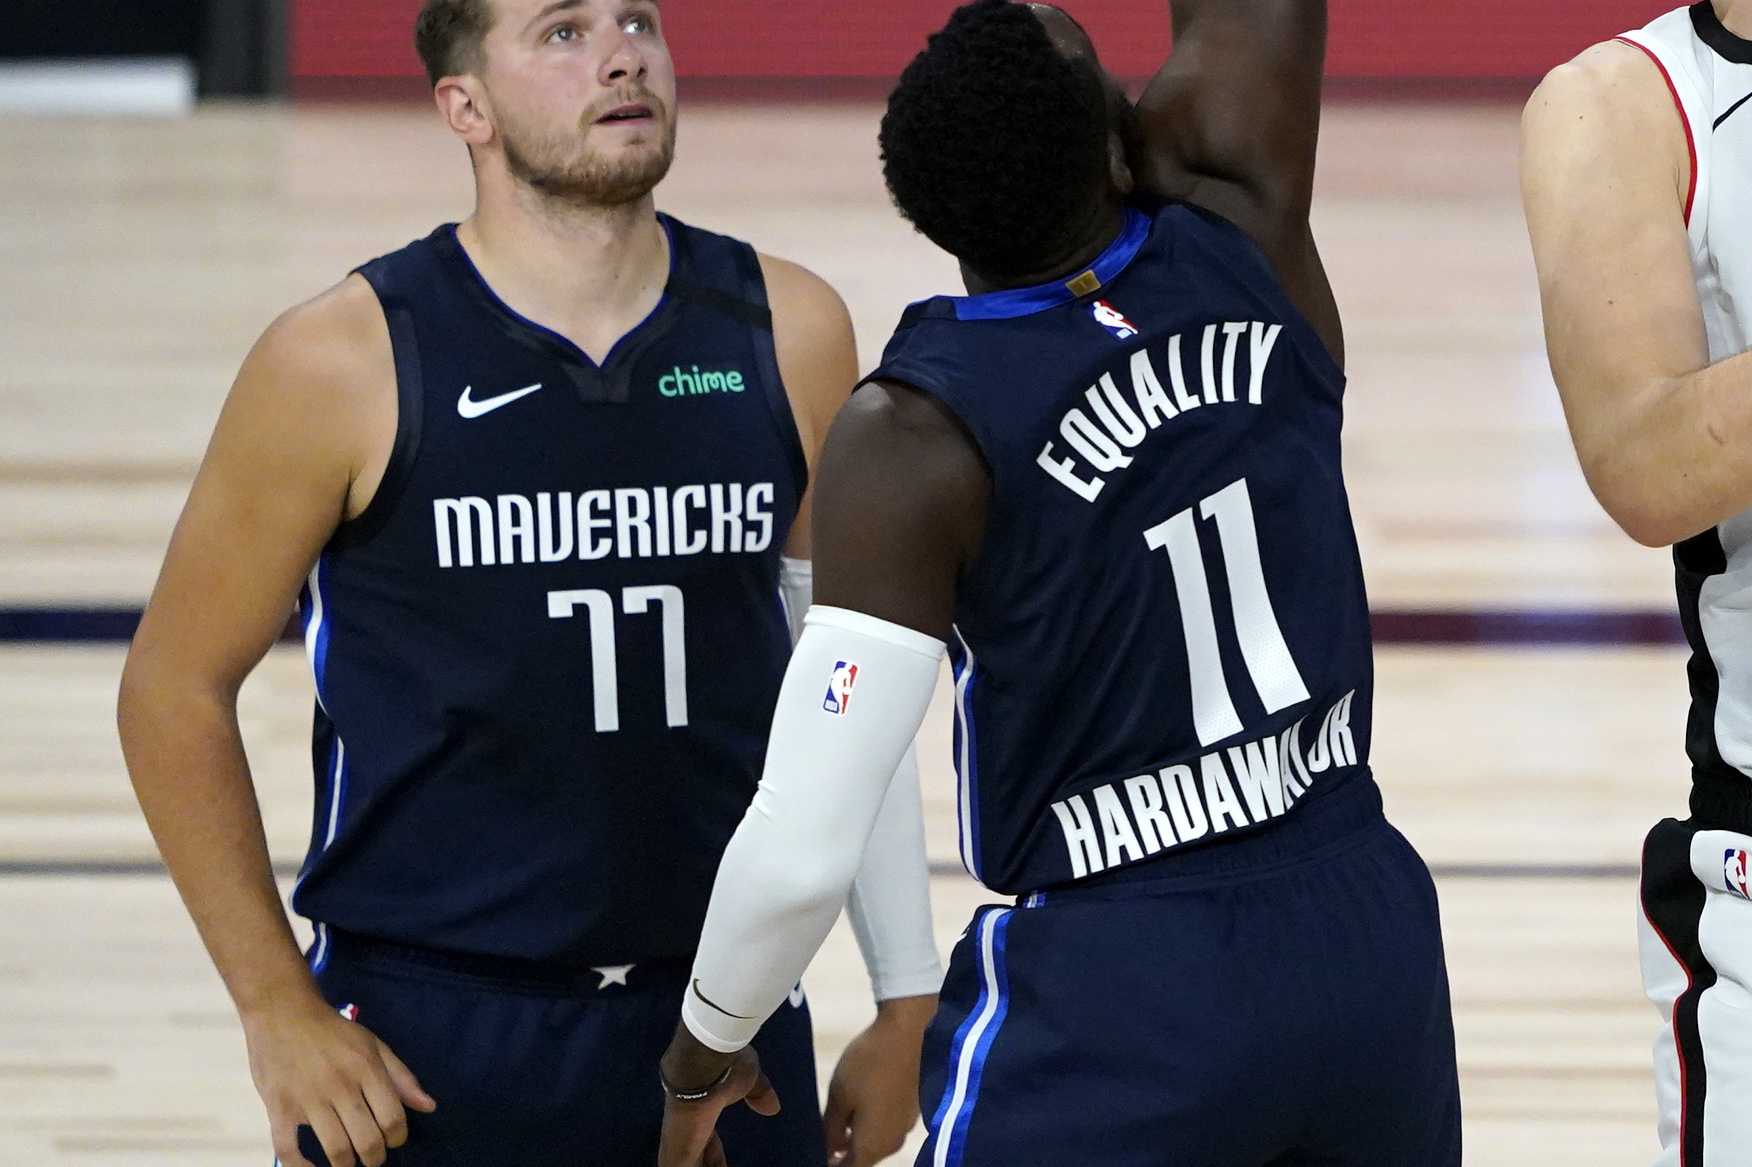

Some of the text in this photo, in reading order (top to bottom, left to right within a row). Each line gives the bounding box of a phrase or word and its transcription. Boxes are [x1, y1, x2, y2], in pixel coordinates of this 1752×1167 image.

[659, 365, 746, 398] chime
[1035, 321, 1283, 503] EQUALITY
[433, 482, 775, 569] MAVERICKS
[546, 584, 689, 733] 77
[1143, 477, 1311, 747] 11
